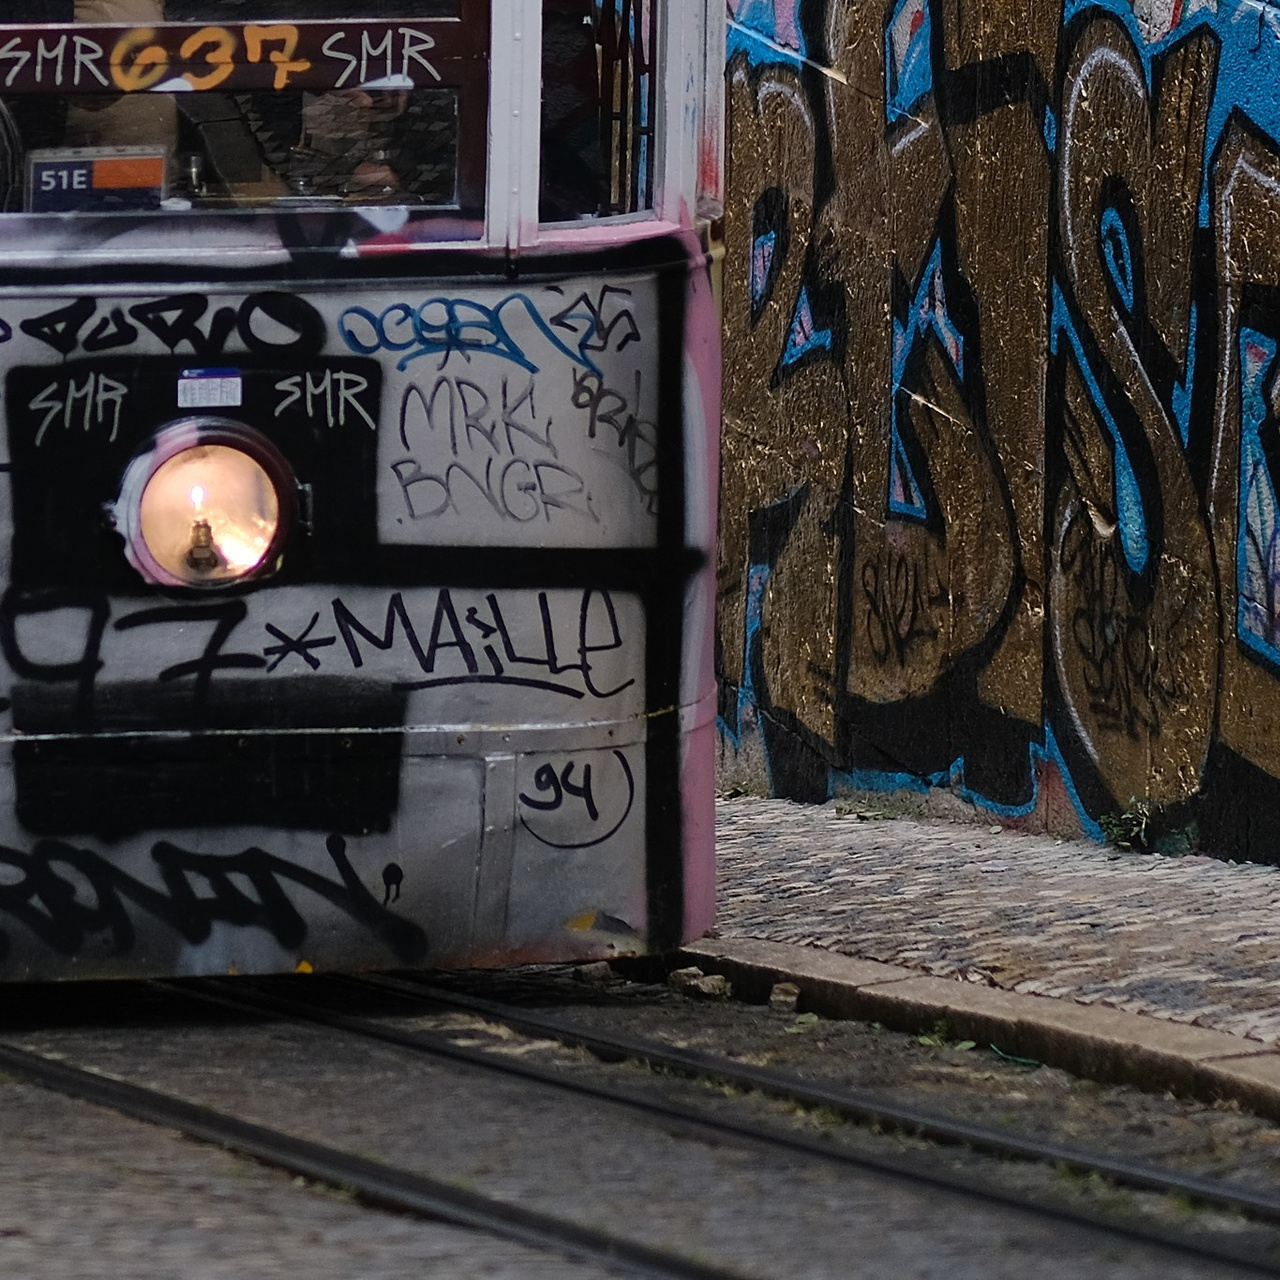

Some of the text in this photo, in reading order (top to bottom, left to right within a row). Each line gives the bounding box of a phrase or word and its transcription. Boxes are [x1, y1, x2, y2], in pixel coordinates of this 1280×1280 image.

[322, 27, 440, 87] SMR
[41, 169, 87, 191] 51E
[274, 368, 376, 431] SMR
